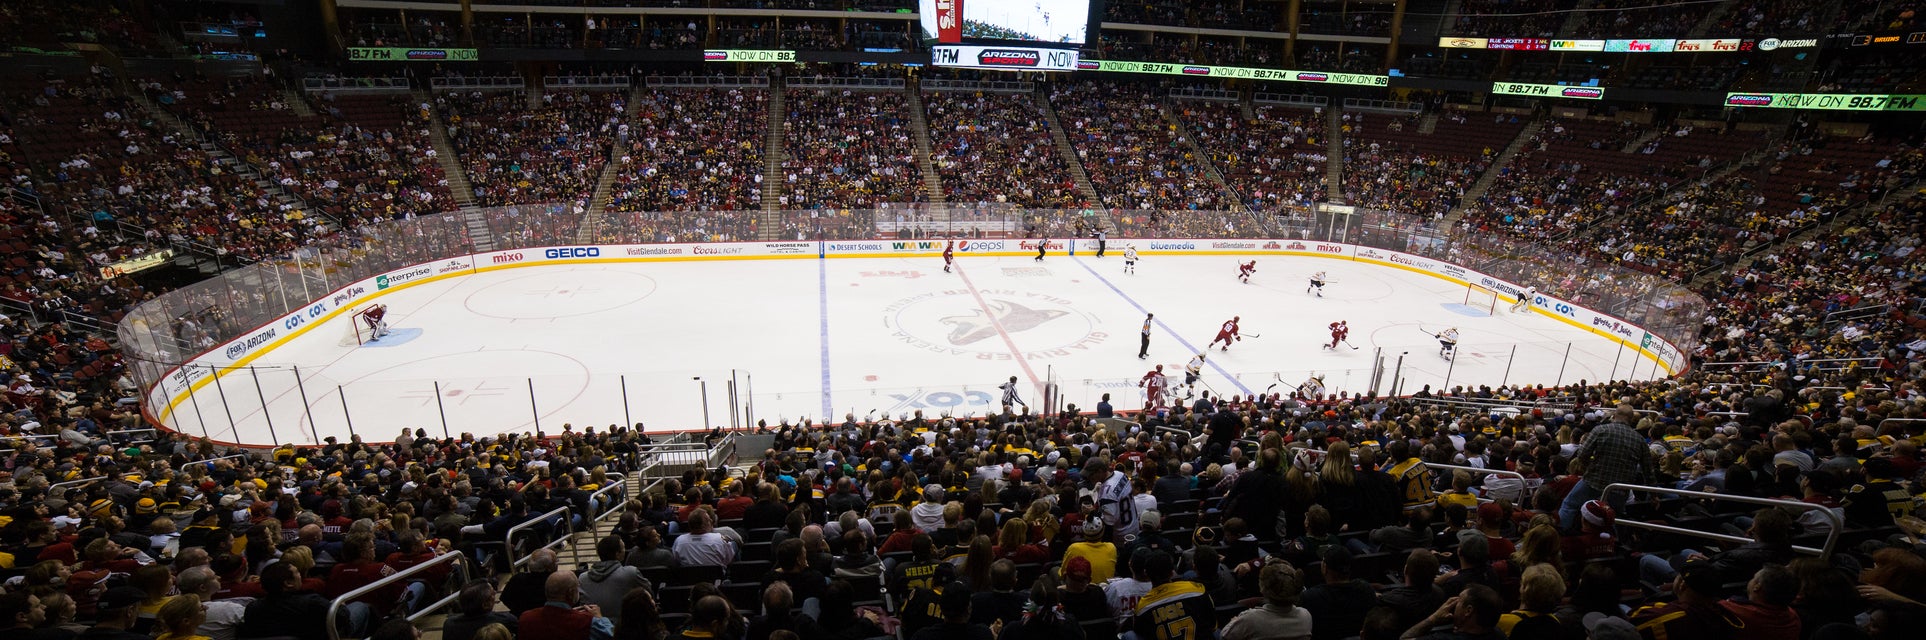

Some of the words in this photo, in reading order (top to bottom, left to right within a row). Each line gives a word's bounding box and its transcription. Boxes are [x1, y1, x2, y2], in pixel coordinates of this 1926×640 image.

[1629, 40, 1651, 51] fry's
[1677, 41, 1699, 51] fry's
[1712, 39, 1737, 51] fry's
[1780, 39, 1817, 48] ARIZONA
[373, 50, 391, 59] FM
[453, 50, 478, 59] NOW
[732, 52, 756, 60] NOW
[760, 52, 773, 60] ON
[942, 49, 959, 63] FM
[1048, 52, 1074, 67] NOW
[1104, 62, 1124, 70] NOW
[1127, 63, 1139, 71] ON
[1142, 64, 1160, 72] 98.7
[1161, 64, 1173, 72] FM
[1214, 67, 1235, 76] NOW
[1238, 68, 1251, 77] ON
[1254, 70, 1273, 78] 98.7
[1273, 71, 1287, 79] FM
[1332, 74, 1355, 83] NOW
[1357, 75, 1371, 84] ON
[1508, 85, 1531, 93] 98.7
[1532, 86, 1549, 94] FM
[1778, 95, 1815, 107] NOW
[1818, 96, 1844, 107] ON
[1848, 97, 1887, 108] 98.7
[1887, 97, 1918, 108] FM
[693, 245, 718, 255] Coors
[971, 240, 1004, 252] pepsi
[1019, 241, 1039, 250] fry's
[1044, 240, 1063, 250] fry's
[1151, 242, 1195, 250] bluemedia
[1212, 242, 1255, 250] VisitGlendale.com
[545, 247, 600, 259] GEICO
[626, 248, 683, 256] VisitGlendale.com
[1390, 253, 1411, 265] Coors
[1411, 260, 1434, 270] LIGHT
[381, 267, 430, 286] enterprise
[1535, 296, 1549, 308] OX
[309, 304, 327, 318] COX
[1556, 303, 1575, 317] COX
[285, 315, 304, 330] COX
[229, 344, 242, 355] FOX
[247, 328, 276, 350] ARIZONA
[887, 390, 993, 411] COX
